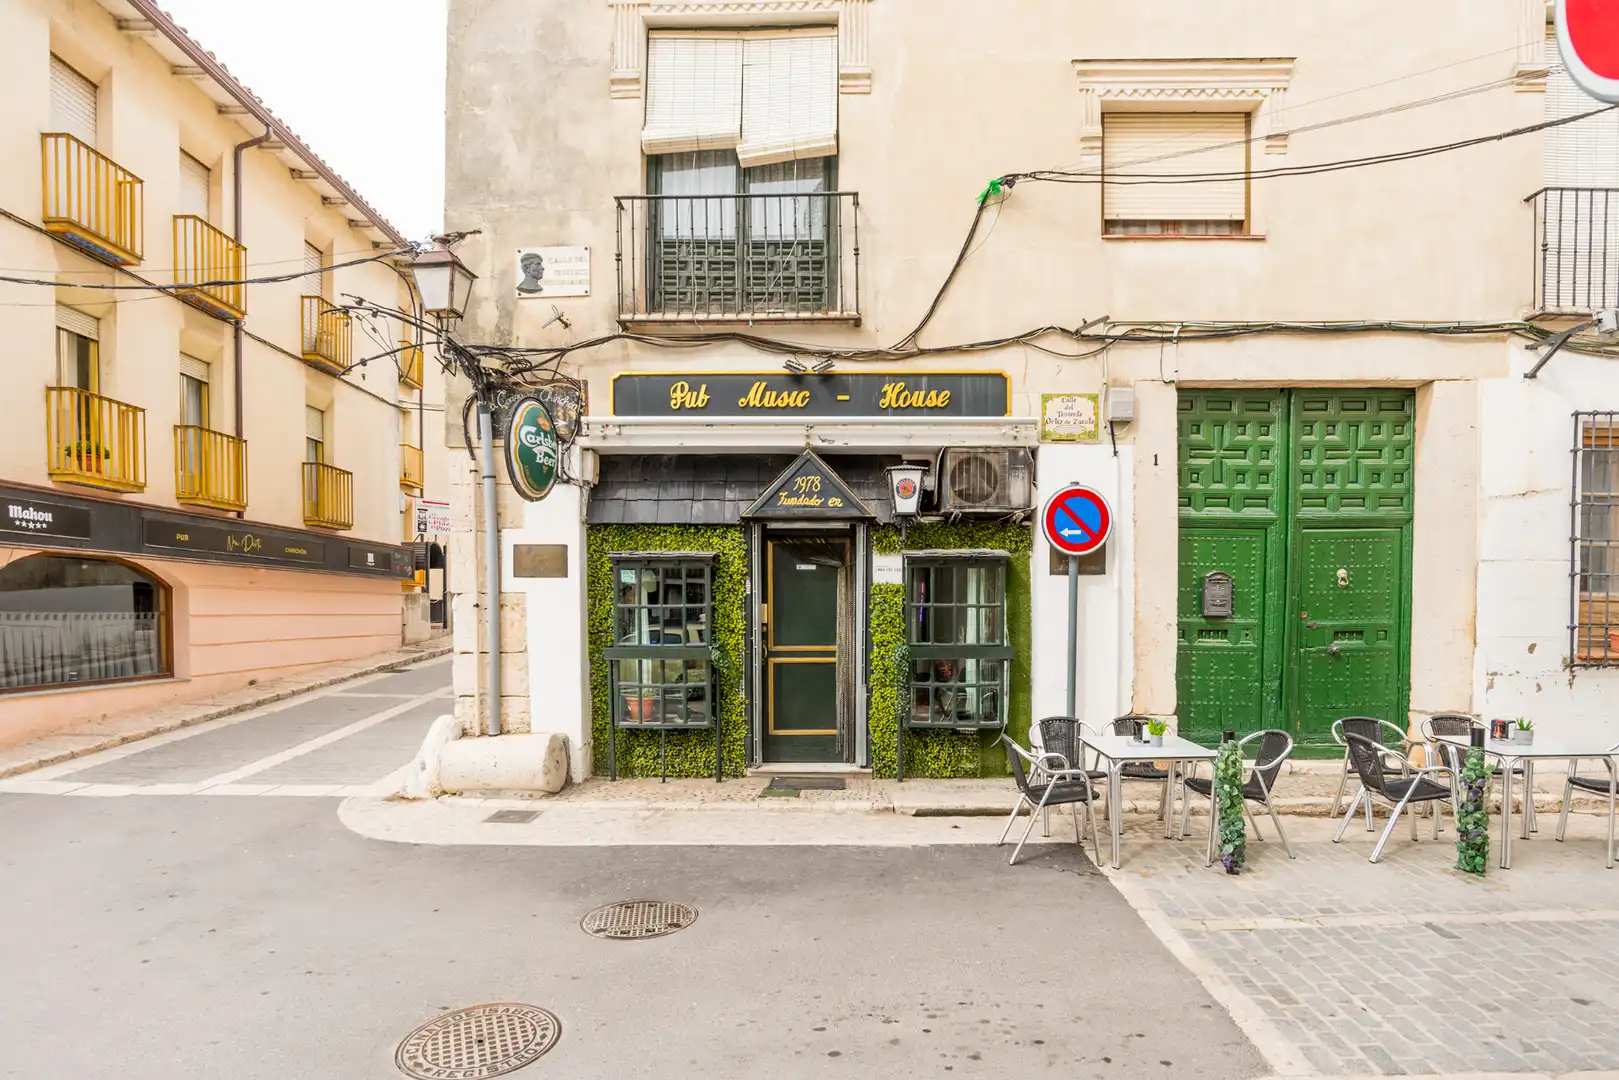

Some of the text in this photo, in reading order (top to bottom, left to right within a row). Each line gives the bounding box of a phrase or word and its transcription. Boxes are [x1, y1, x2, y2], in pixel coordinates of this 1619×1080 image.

[670, 380, 710, 409] Pub
[738, 381, 810, 408] Music
[879, 381, 950, 409] House
[1153, 453, 1159, 466] 1
[793, 475, 821, 494] 1978
[777, 491, 844, 507] Fundado en
[8, 504, 53, 523] Mahou
[176, 533, 189, 541] PUB
[406, 1017, 450, 1054] CANAL
[451, 1010, 478, 1022] DE
[482, 1007, 542, 1022] ISABEL
[431, 1048, 539, 1079] REGISTRO
